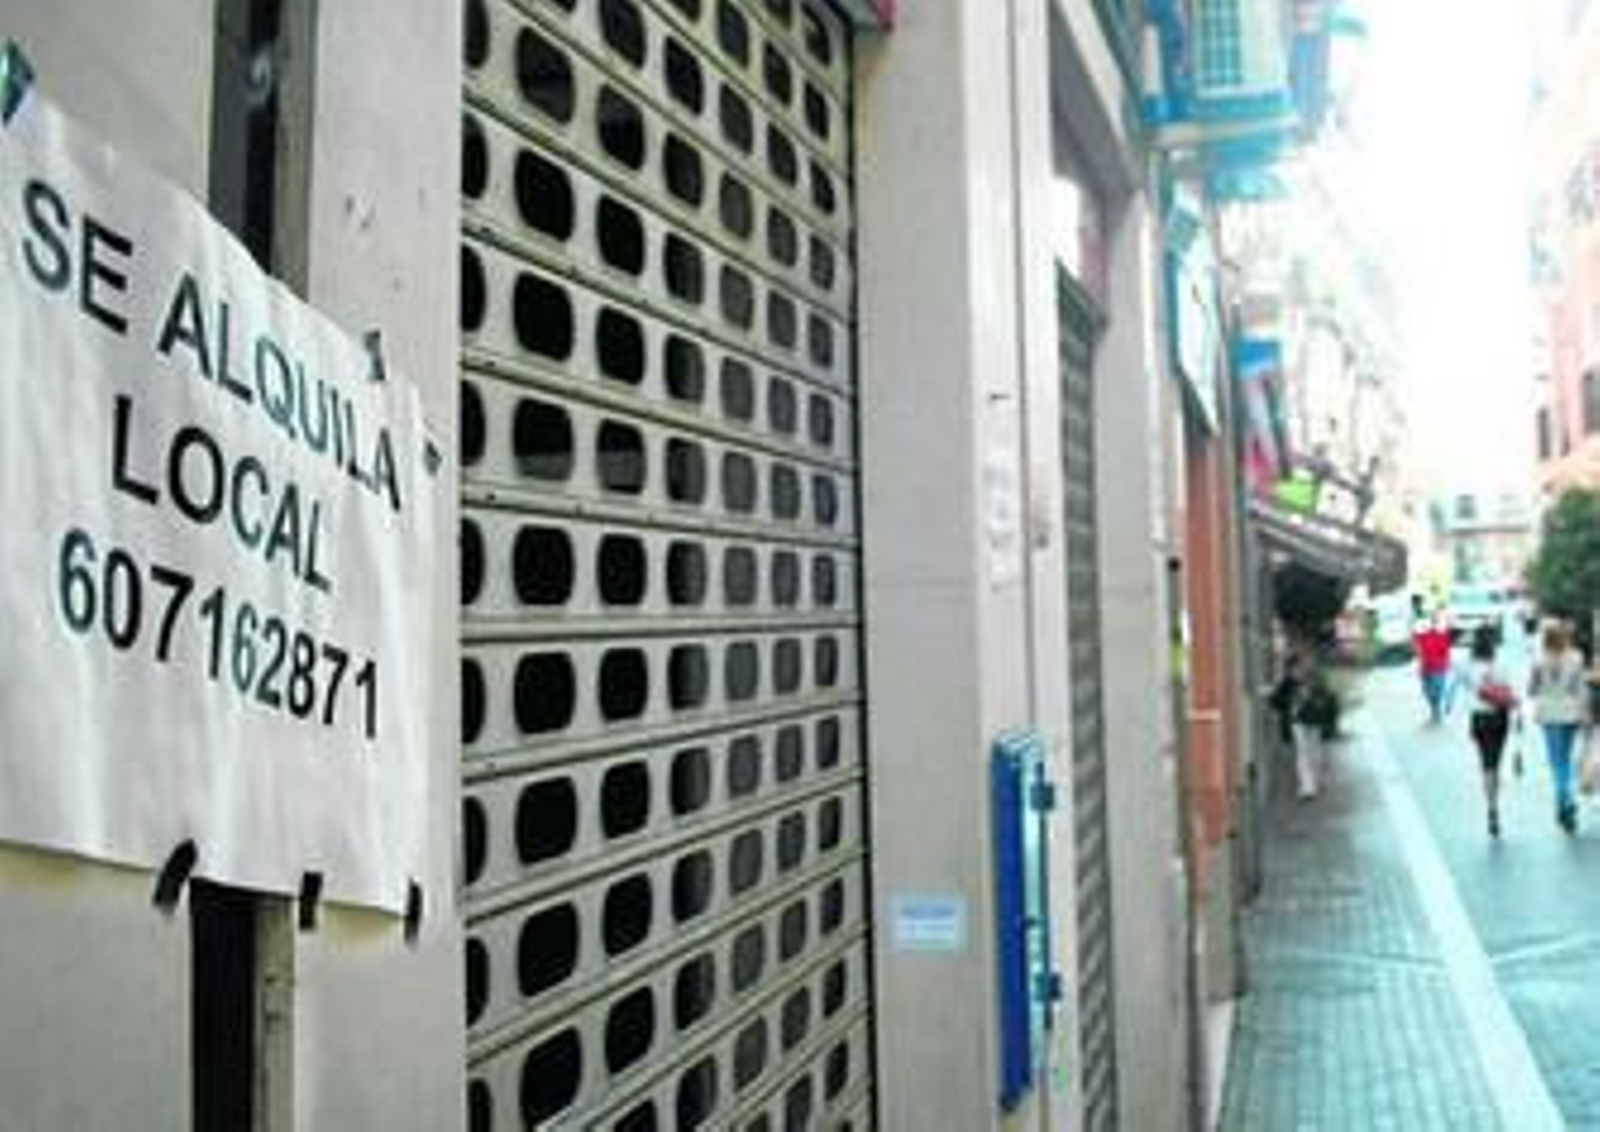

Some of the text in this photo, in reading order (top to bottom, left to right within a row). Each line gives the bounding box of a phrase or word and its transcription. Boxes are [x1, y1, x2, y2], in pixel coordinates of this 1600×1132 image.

[21, 178, 403, 511] SE ALQUILA
[113, 395, 332, 593] LOCAL
[59, 528, 378, 740] 607162871
